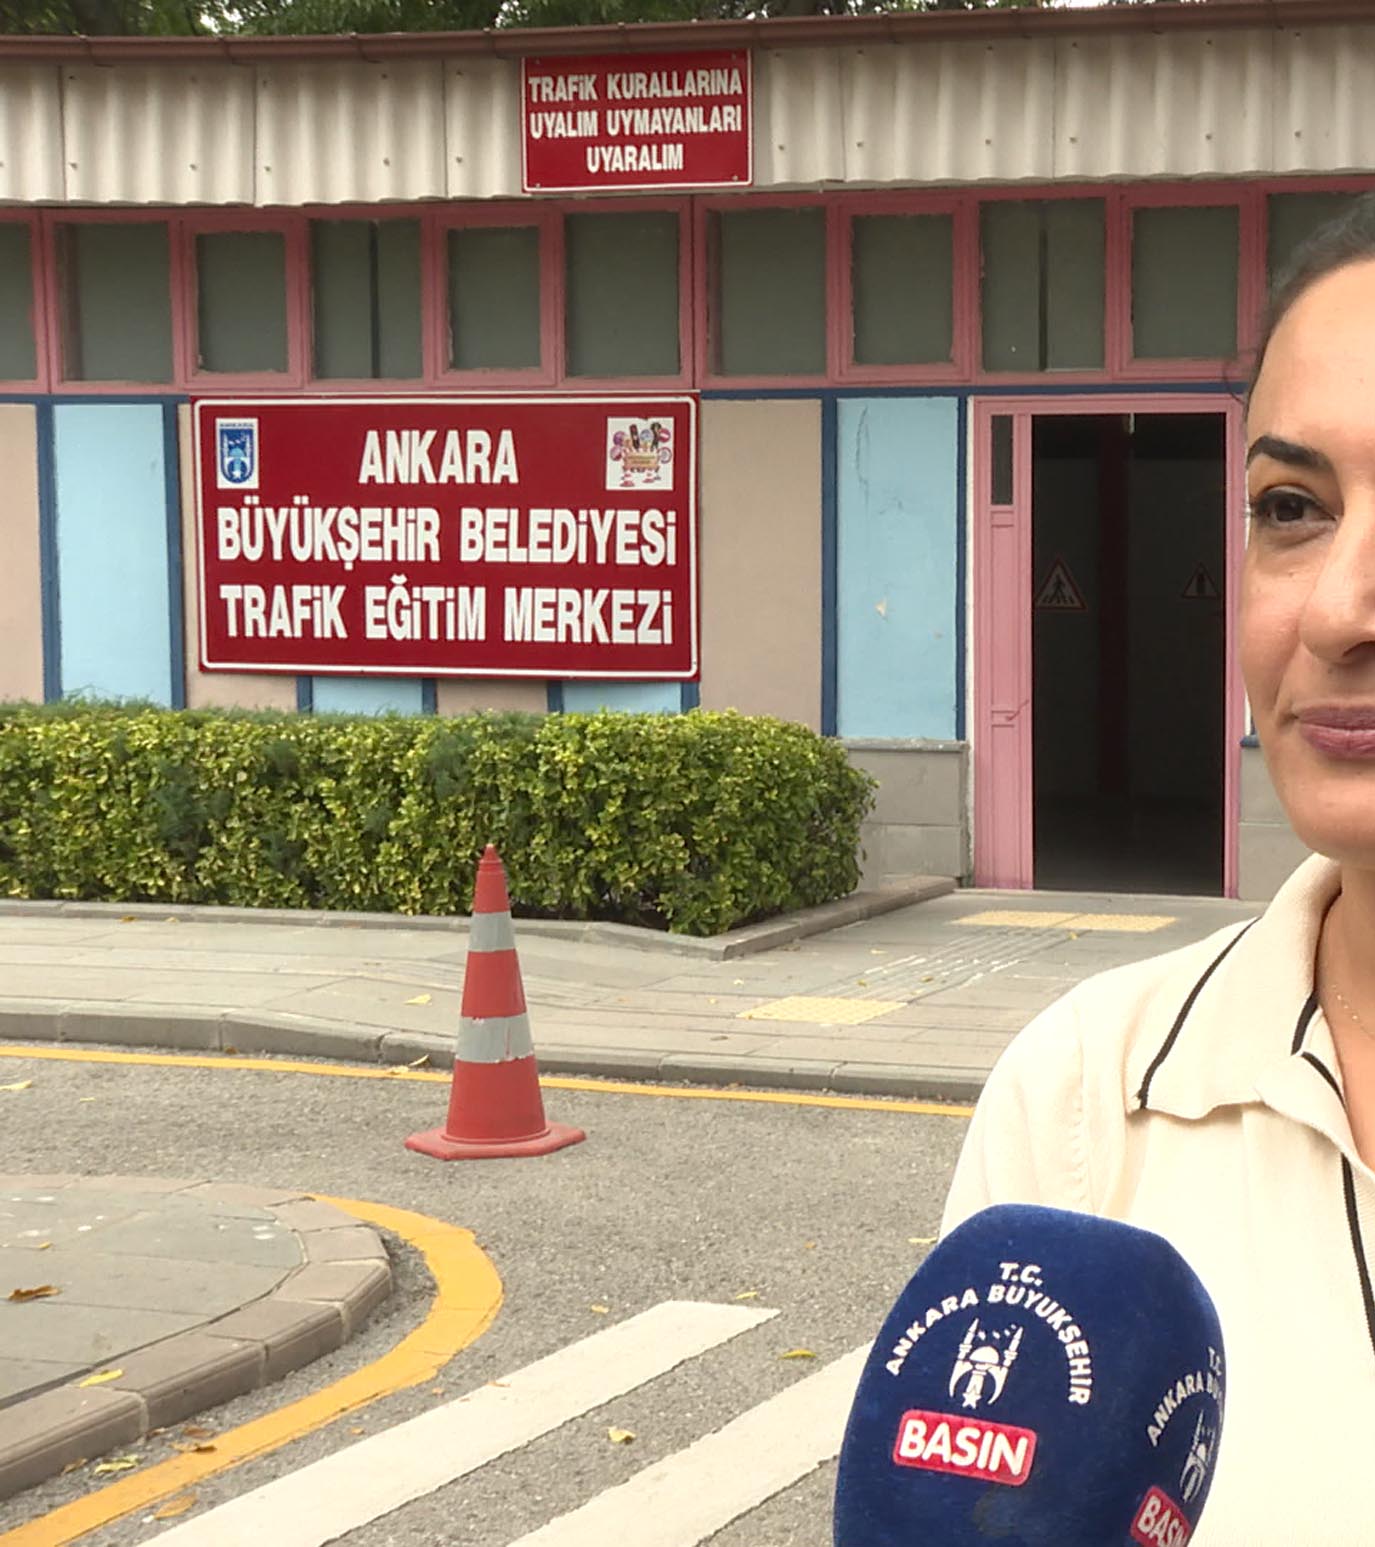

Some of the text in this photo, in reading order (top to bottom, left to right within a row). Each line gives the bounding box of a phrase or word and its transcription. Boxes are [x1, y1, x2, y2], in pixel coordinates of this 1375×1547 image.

[607, 68, 743, 100] KURALLARINA
[530, 104, 742, 139] UYALIM UYMAYANLARI
[586, 144, 684, 174] UYARALIM
[358, 429, 519, 484] ANKARA
[999, 1262, 1043, 1287] T.C.
[886, 1288, 979, 1376] ANKARA
[1147, 1371, 1204, 1447] ANKARA
[899, 1418, 1029, 1476] BASIN
